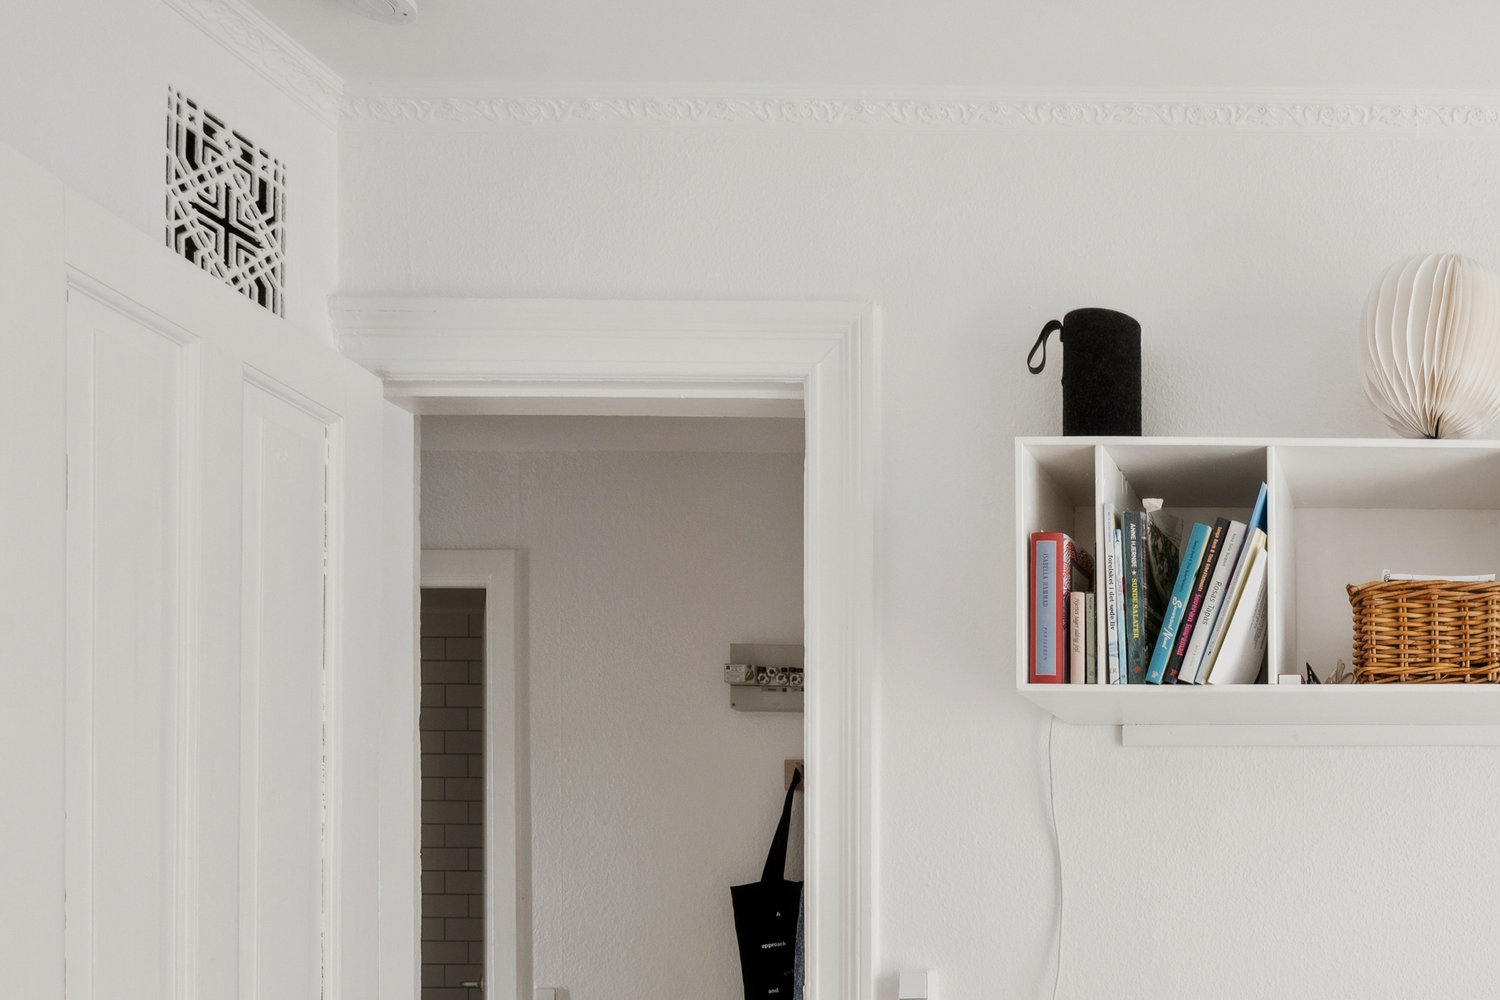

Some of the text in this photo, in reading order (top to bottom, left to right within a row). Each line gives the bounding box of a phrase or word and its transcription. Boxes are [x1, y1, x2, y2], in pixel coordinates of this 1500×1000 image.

[1202, 581, 1223, 625] Rosas Tapas
[761, 940, 787, 949] approach
